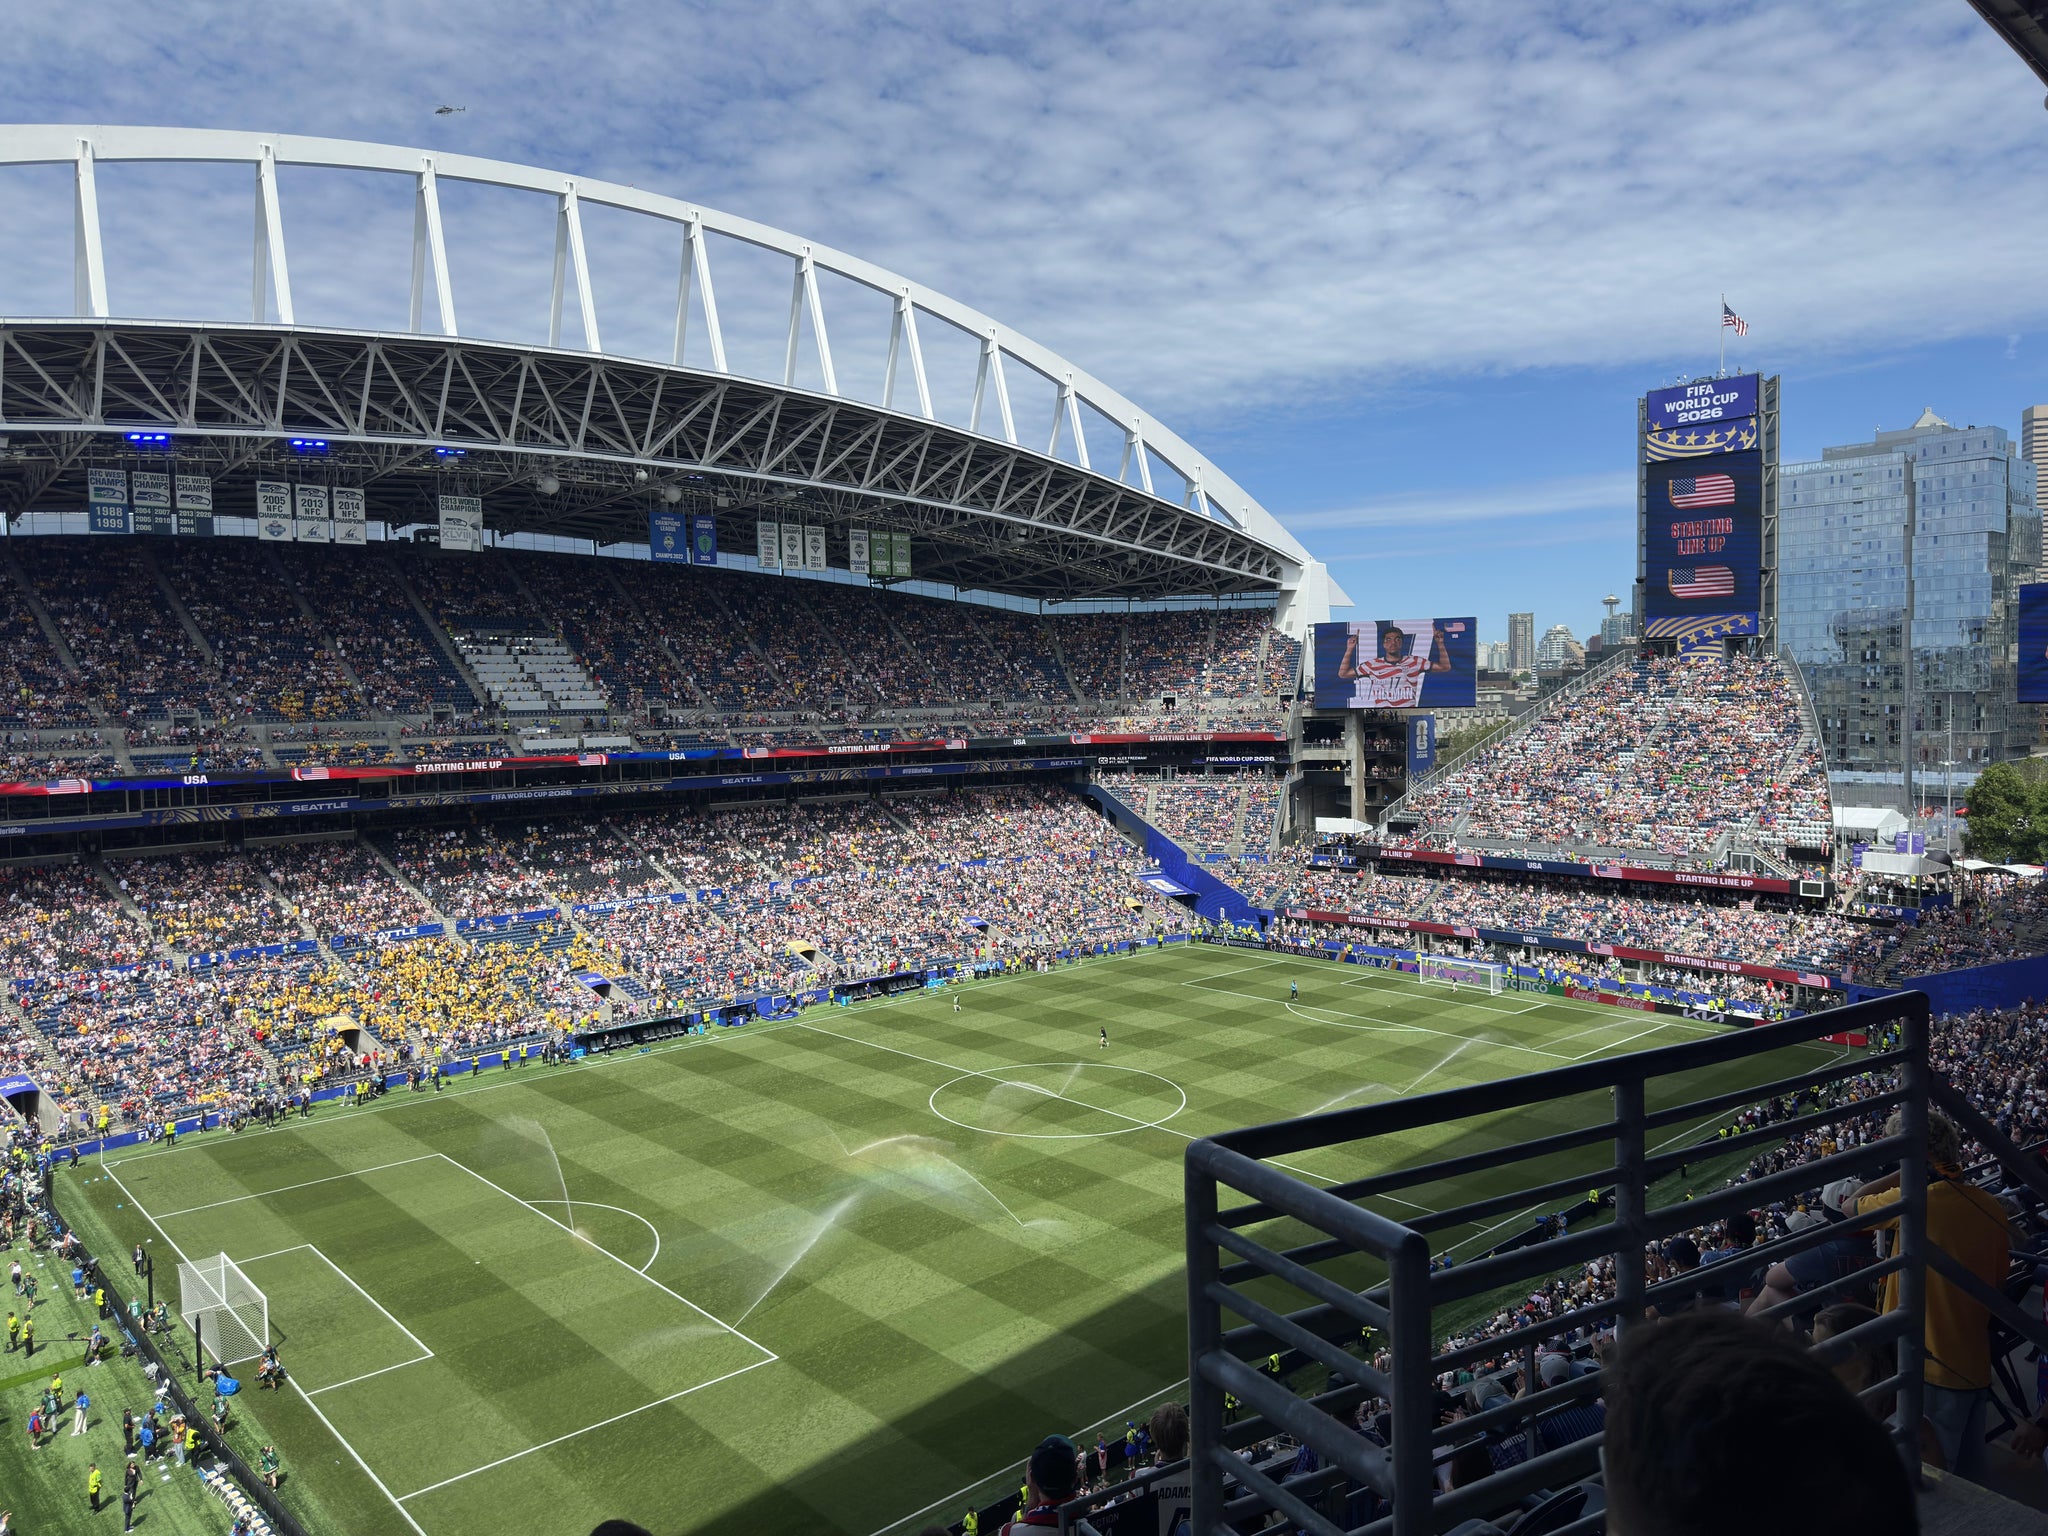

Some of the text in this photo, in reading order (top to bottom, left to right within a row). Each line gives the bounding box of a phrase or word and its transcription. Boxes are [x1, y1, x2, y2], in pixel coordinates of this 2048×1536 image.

[1687, 384, 1714, 397] FIFA
[1665, 392, 1739, 413] WORLD CUP
[1678, 407, 1723, 423] 2026
[89, 470, 126, 479] AFC WEST
[134, 473, 169, 482] NFC WEST
[90, 478, 126, 487] CHAMPS
[177, 476, 190, 484] NFC
[134, 481, 169, 490] CHAMPS
[177, 484, 211, 493] CHAMPS
[263, 495, 286, 505] 2005
[301, 498, 323, 508] 2013
[440, 497, 480, 506] 2013 WORLD
[96, 506, 123, 516] 1988
[267, 504, 283, 513] NFC
[338, 501, 360, 511] 2014
[440, 504, 480, 512] CHAMPIONS
[259, 511, 291, 519] CHAMPIONS
[342, 510, 358, 518] NFC
[97, 518, 124, 528] 1999
[1671, 517, 1733, 538] STARTING
[441, 530, 471, 539] XLVIII
[1678, 536, 1726, 555] LINE UP
[1373, 687, 1413, 700] TILLMAN
[1013, 738, 1026, 746] USA
[828, 745, 863, 753] STARTING
[864, 744, 880, 752] LINE
[415, 760, 503, 773] STARTING LINE UP
[183, 775, 209, 785] USA
[721, 777, 763, 785] SEATTLE
[548, 789, 573, 797] 2026
[291, 802, 349, 812] SEATTLE
[1388, 850, 1403, 858] LINE
[1403, 851, 1413, 859] UP
[1527, 861, 1543, 870] USA
[1675, 873, 1754, 887] STARTING LINE UP
[588, 903, 605, 911] FIFA
[1348, 915, 1382, 926] STARTING
[1383, 919, 1399, 927] LINE
[1523, 935, 1539, 945] USA
[1270, 942, 1295, 954] QATAR
[1297, 946, 1330, 959] AIRWAYS
[1355, 954, 1377, 967] VISA
[1664, 954, 1742, 972] STARTING LINE UP
[1496, 976, 1548, 994] aramco
[1499, 1432, 1526, 1450] UNITED
